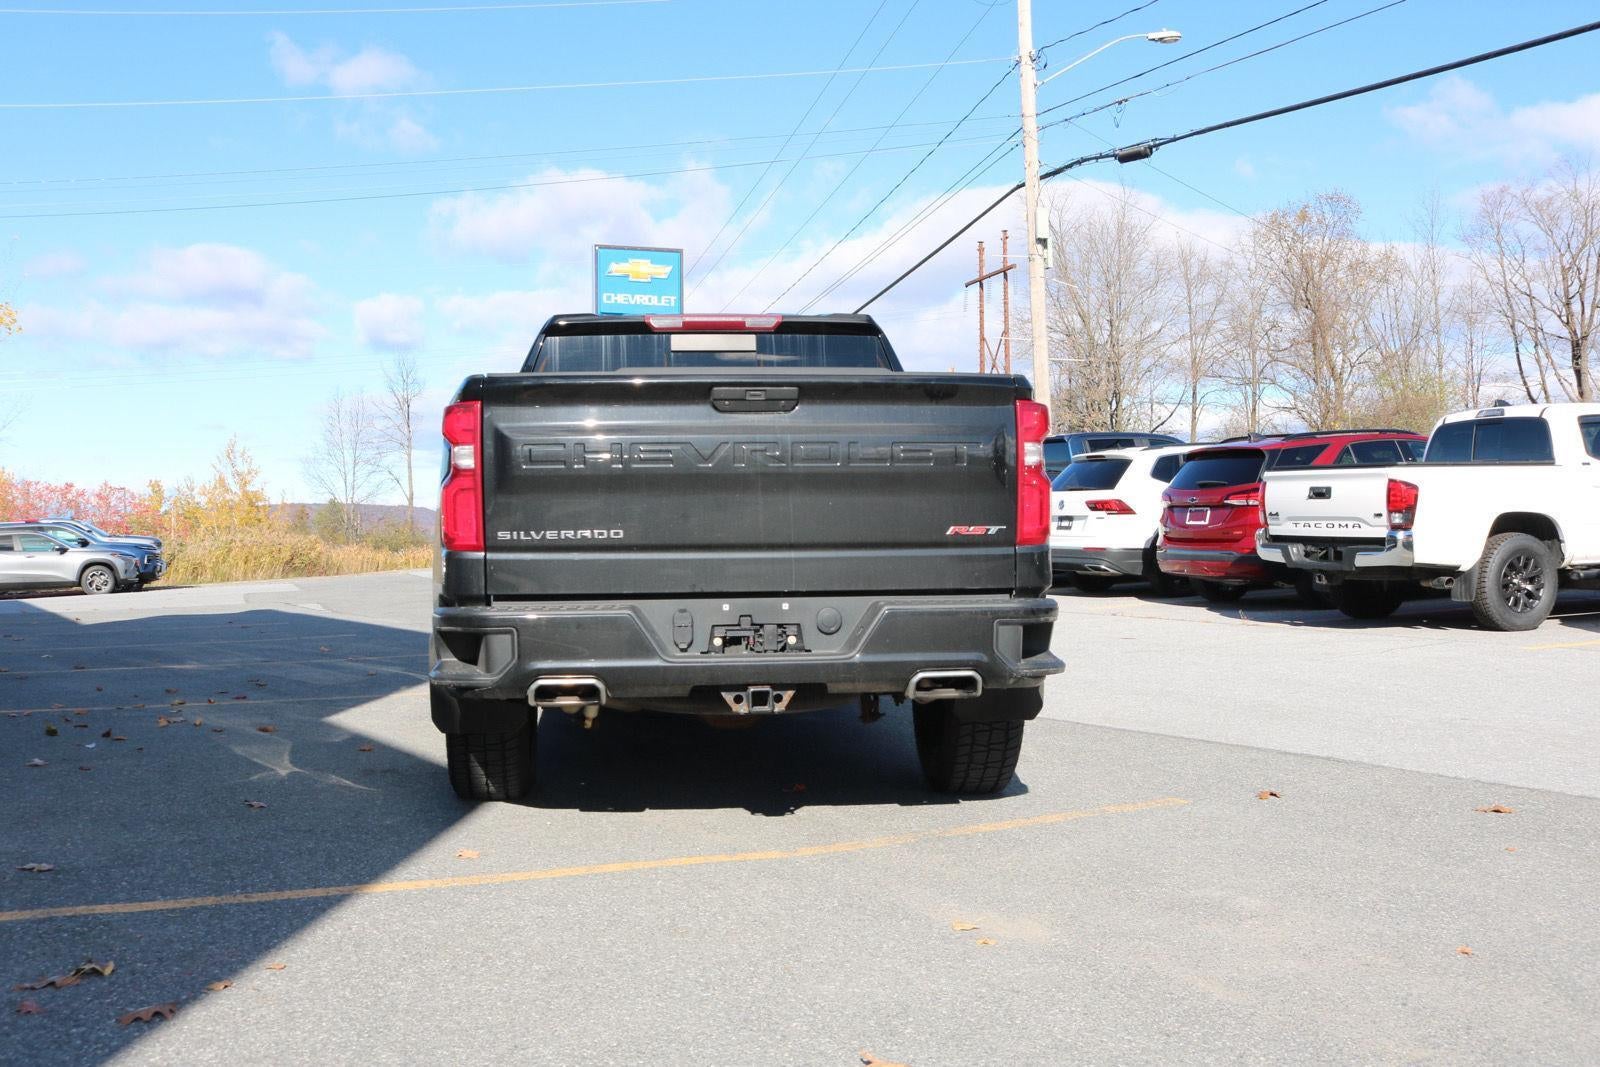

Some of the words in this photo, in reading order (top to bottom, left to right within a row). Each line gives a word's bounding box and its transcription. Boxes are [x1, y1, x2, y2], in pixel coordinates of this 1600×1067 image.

[602, 292, 677, 307] CHEVROLET
[520, 441, 984, 468] CHEVROLET
[496, 529, 625, 541] SILVERADO
[946, 525, 1007, 535] RST
